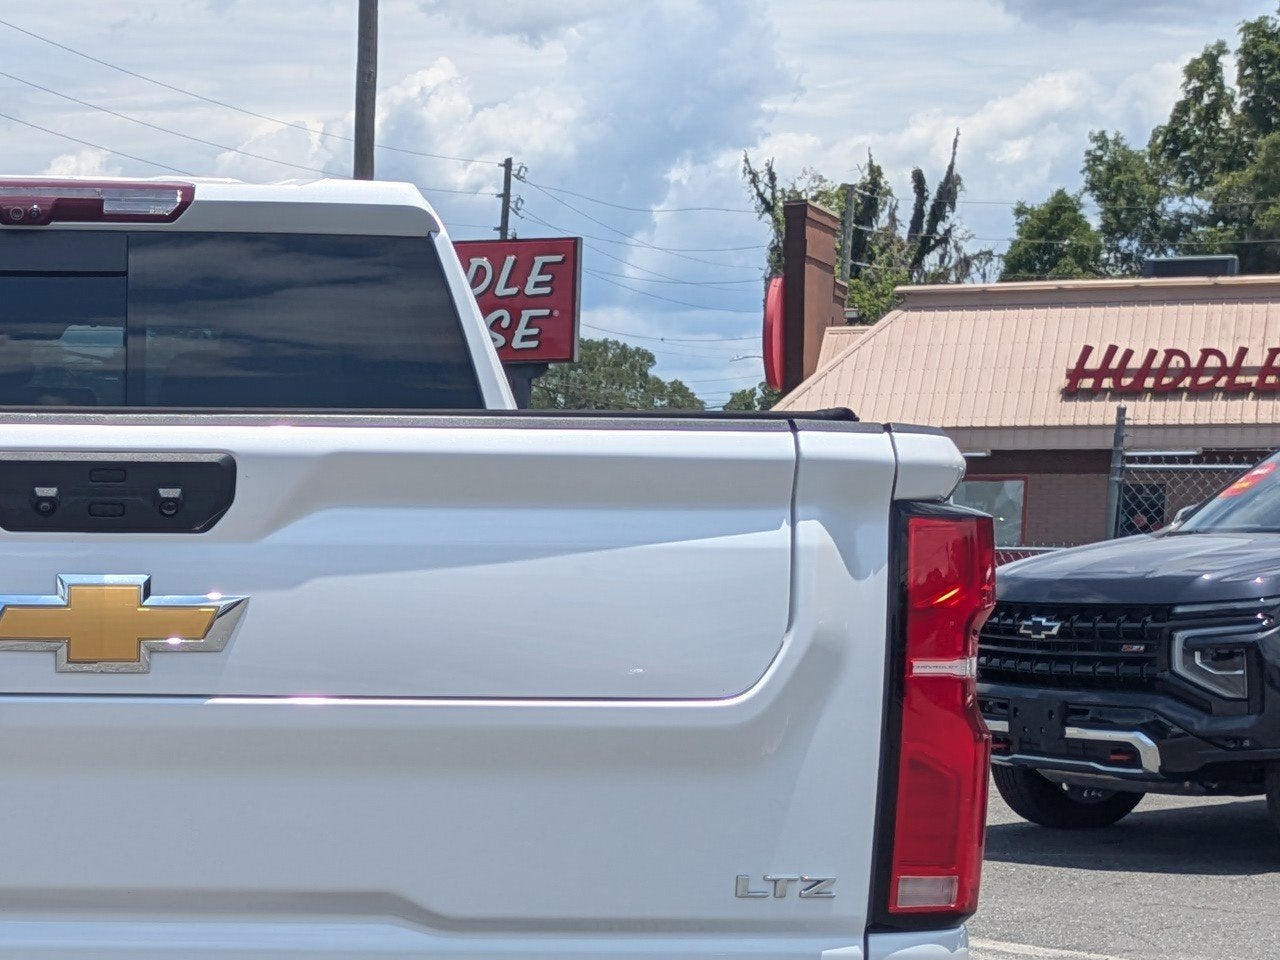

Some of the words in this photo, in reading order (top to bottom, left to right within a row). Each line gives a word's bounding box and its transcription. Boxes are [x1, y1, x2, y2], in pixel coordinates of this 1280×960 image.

[466, 254, 565, 297] DLE
[484, 309, 551, 349] SE
[1065, 344, 1280, 393] HUDDLE
[735, 874, 836, 898] LTZ
